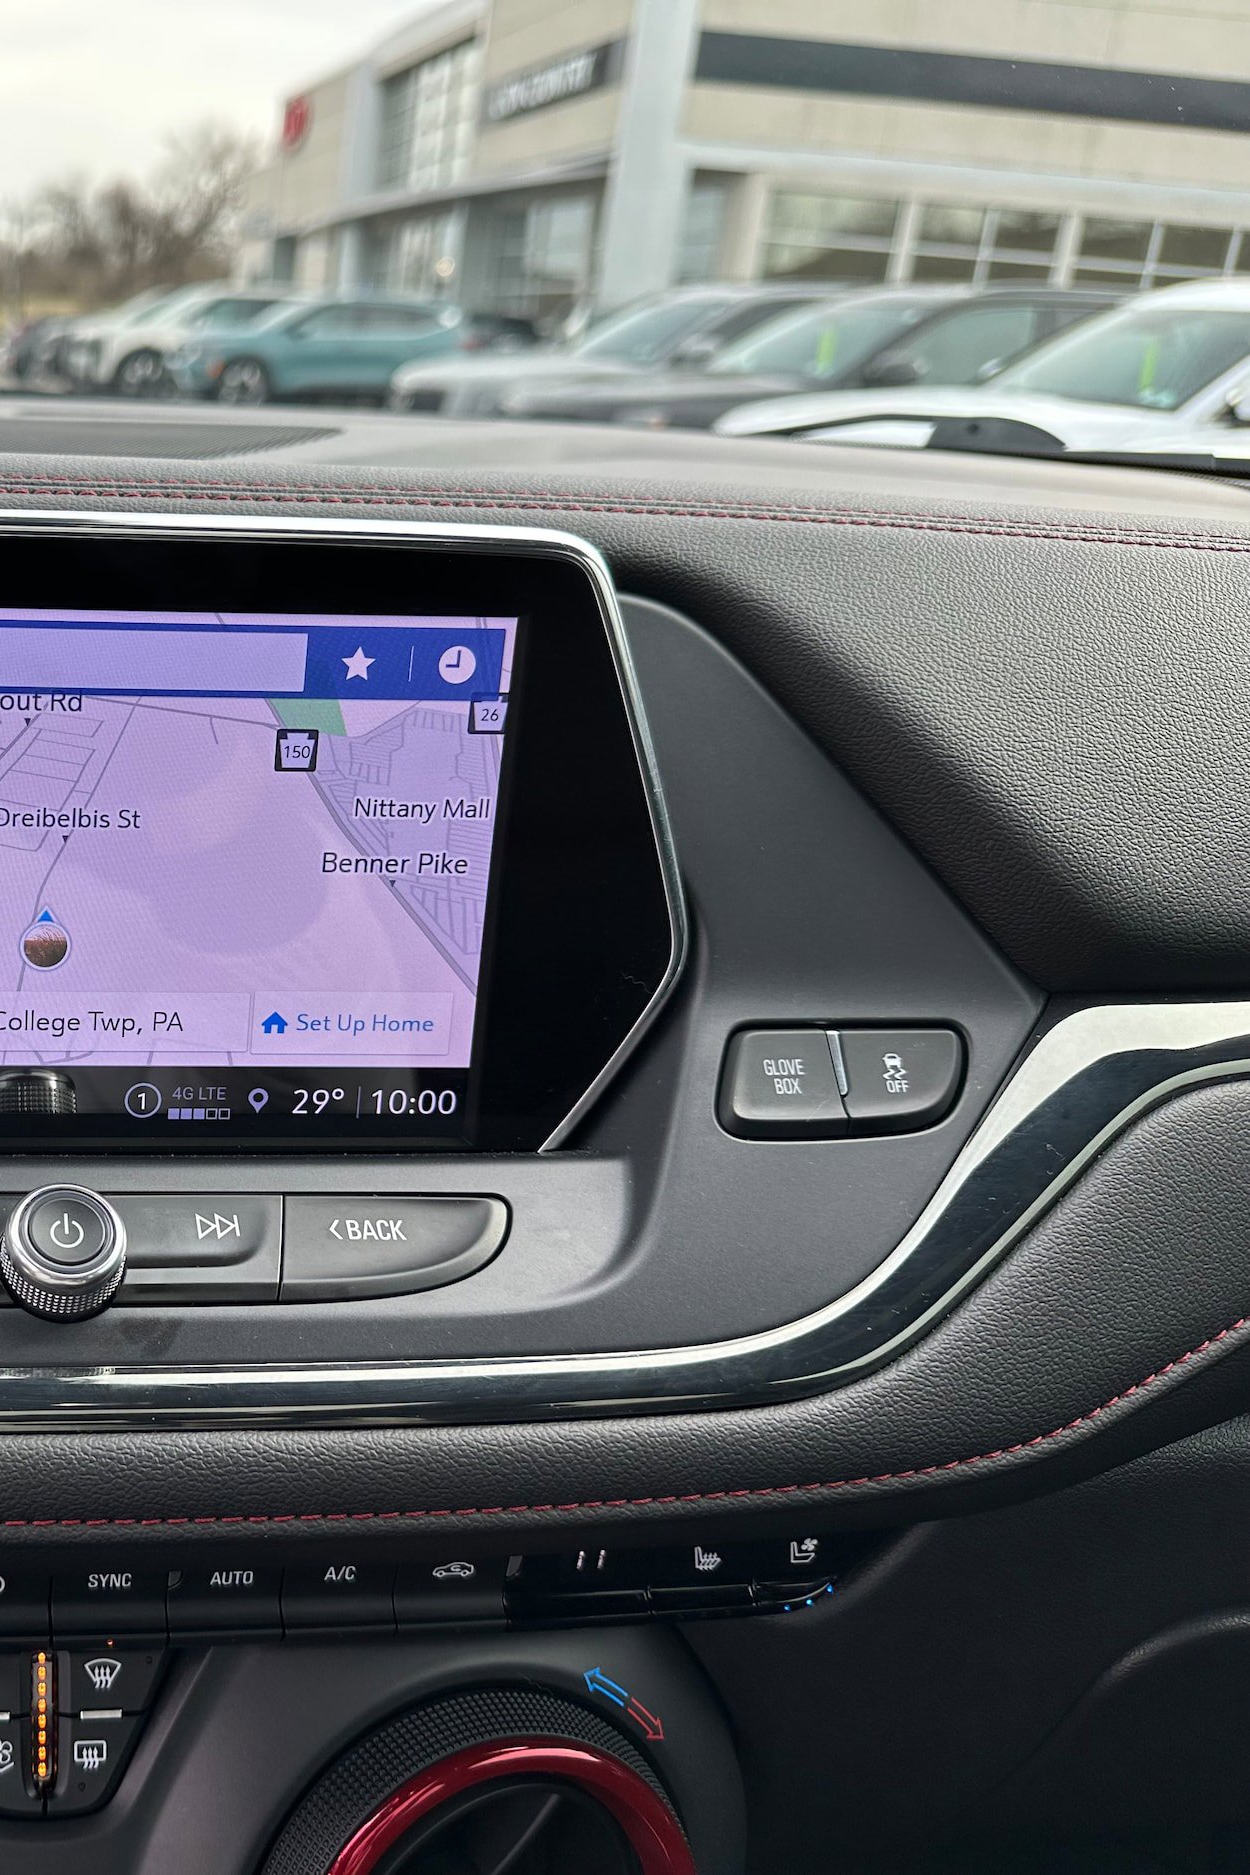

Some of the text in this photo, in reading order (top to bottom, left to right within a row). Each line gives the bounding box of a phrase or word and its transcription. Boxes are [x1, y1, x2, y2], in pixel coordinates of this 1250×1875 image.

[50, 690, 82, 712] Rd
[480, 709, 500, 722] 26
[283, 744, 311, 760] 150
[117, 809, 141, 828] St
[353, 798, 490, 824] Nittany Mall
[321, 852, 468, 875] Benner Pike
[88, 1010, 143, 1037] Twp,
[153, 1012, 184, 1032] PA
[296, 1013, 434, 1036] Set Up Home
[763, 1059, 805, 1076] GLOVE
[172, 1086, 227, 1101] 4G LTE
[774, 1078, 803, 1095] BOX
[886, 1080, 910, 1093] OFF
[291, 1088, 346, 1115] 29°
[371, 1089, 457, 1115] 10:00
[345, 1219, 407, 1241] BACK
[87, 1573, 132, 1589] SYNC
[209, 1571, 254, 1586] AUTO
[324, 1565, 356, 1582] A/C
